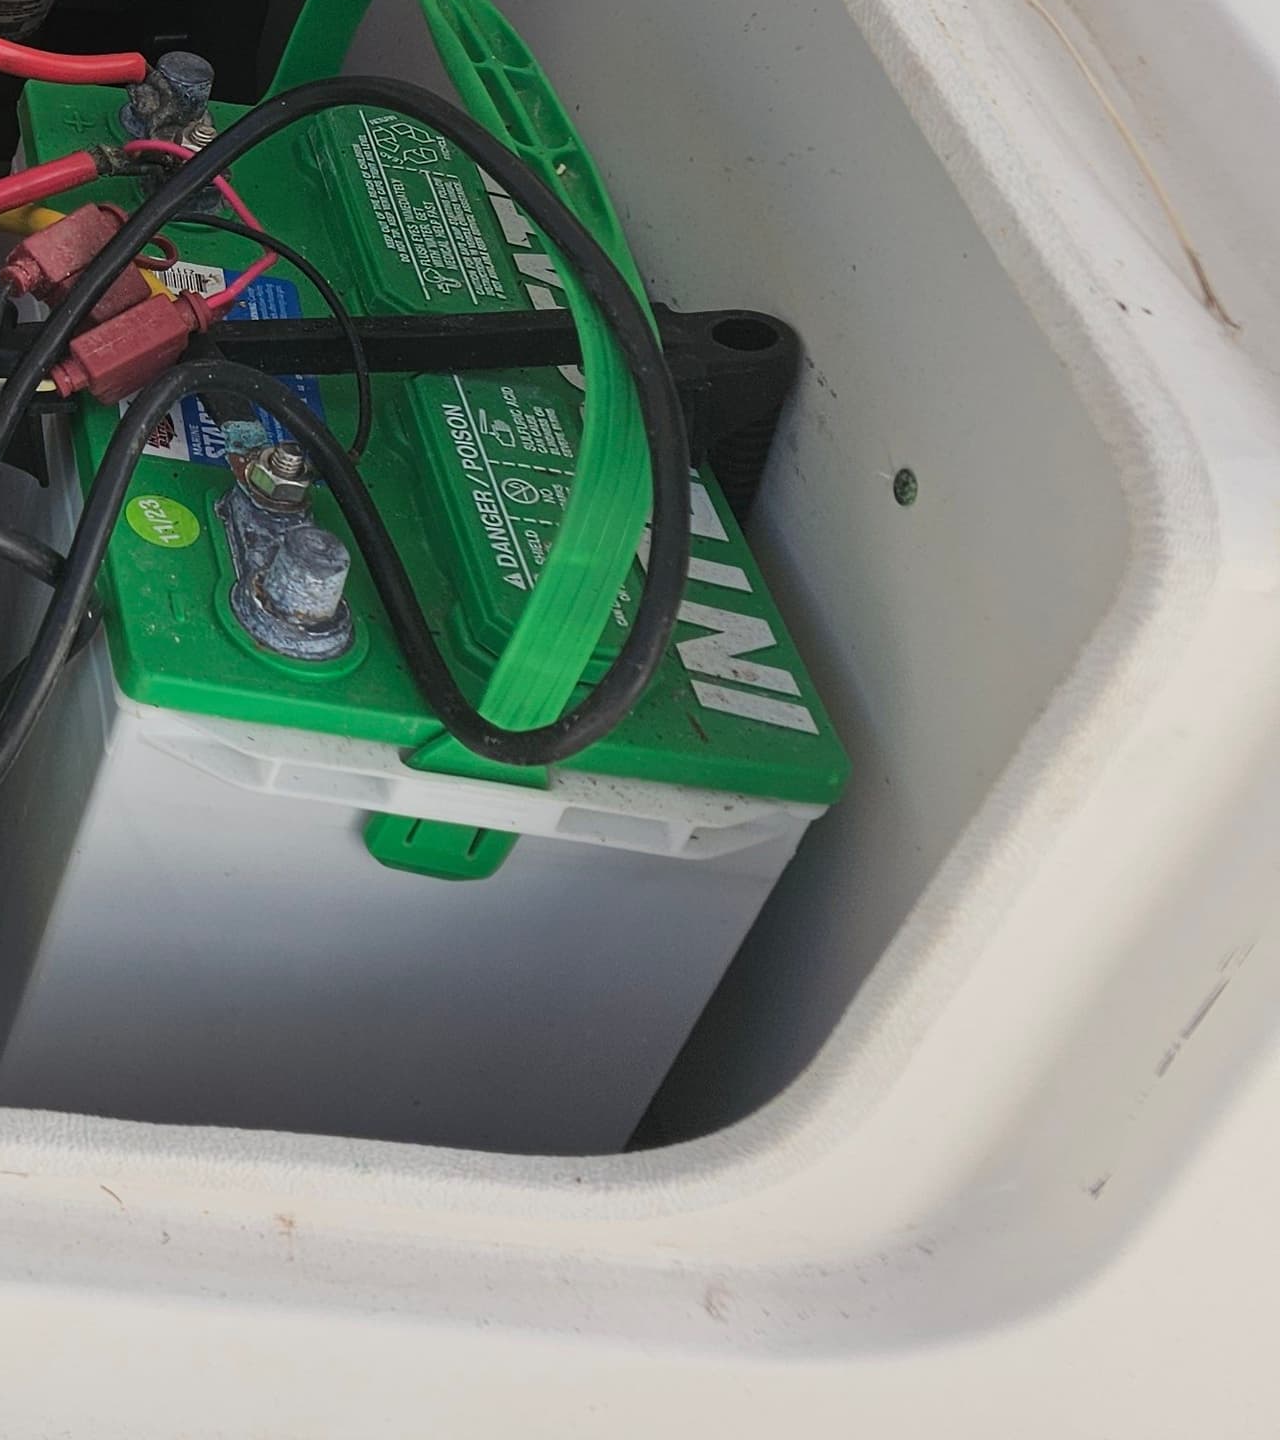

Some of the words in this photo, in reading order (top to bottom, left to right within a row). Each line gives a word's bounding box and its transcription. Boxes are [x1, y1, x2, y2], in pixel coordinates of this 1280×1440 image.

[390, 177, 416, 223] IMMEDIATELY
[412, 206, 427, 221] GET
[422, 200, 438, 218] FAST
[407, 224, 423, 242] EYES
[430, 218, 447, 239] HELP
[414, 243, 431, 267] FLUSH
[438, 239, 458, 270] MEDICAL
[500, 385, 521, 409] ACID
[442, 402, 480, 470] POISON
[510, 410, 538, 452] SULFURIC
[541, 487, 556, 505] NO
[138, 498, 182, 543] 11/23
[473, 490, 519, 568] DANGER
[524, 529, 547, 566] SHIELD
